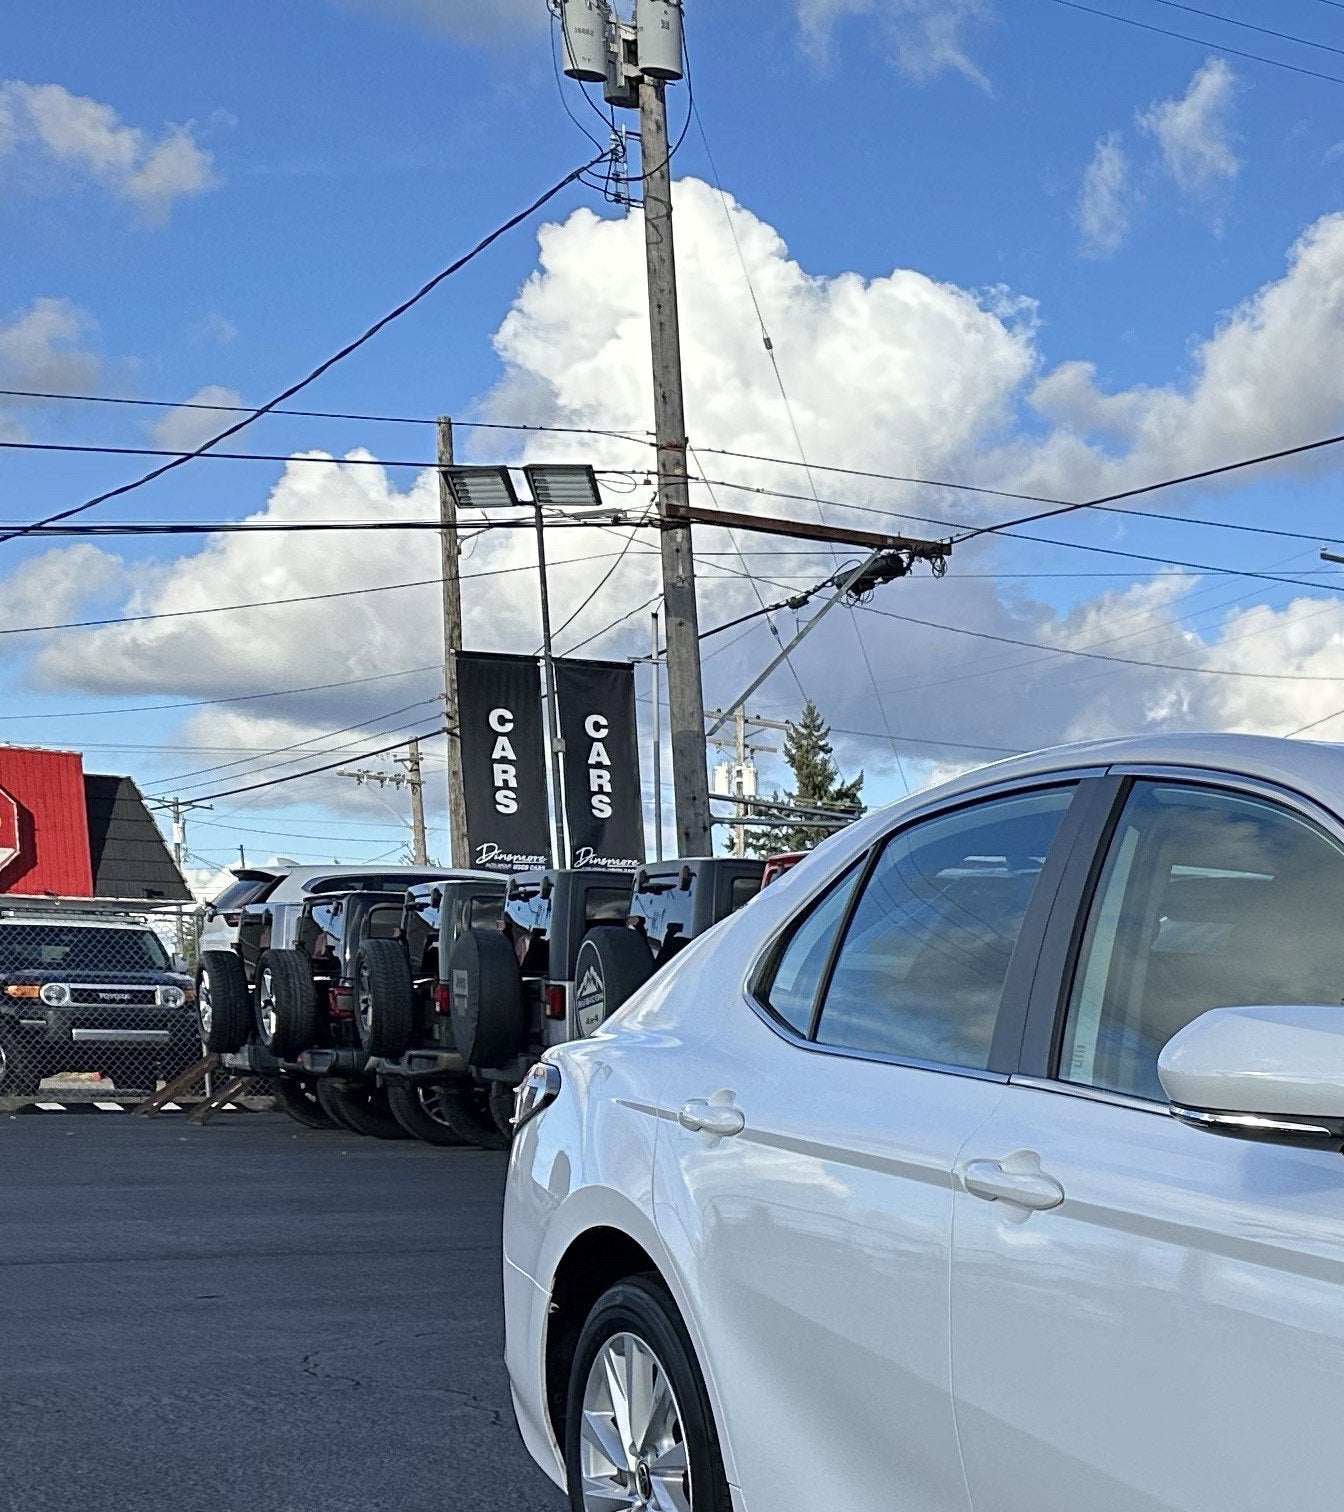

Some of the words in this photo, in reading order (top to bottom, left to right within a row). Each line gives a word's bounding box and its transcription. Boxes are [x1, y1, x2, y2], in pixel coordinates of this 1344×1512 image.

[488, 707, 519, 815] CARS
[584, 713, 613, 819] CARS
[475, 842, 548, 865] Dinsmore
[573, 846, 641, 868] Dinsmore
